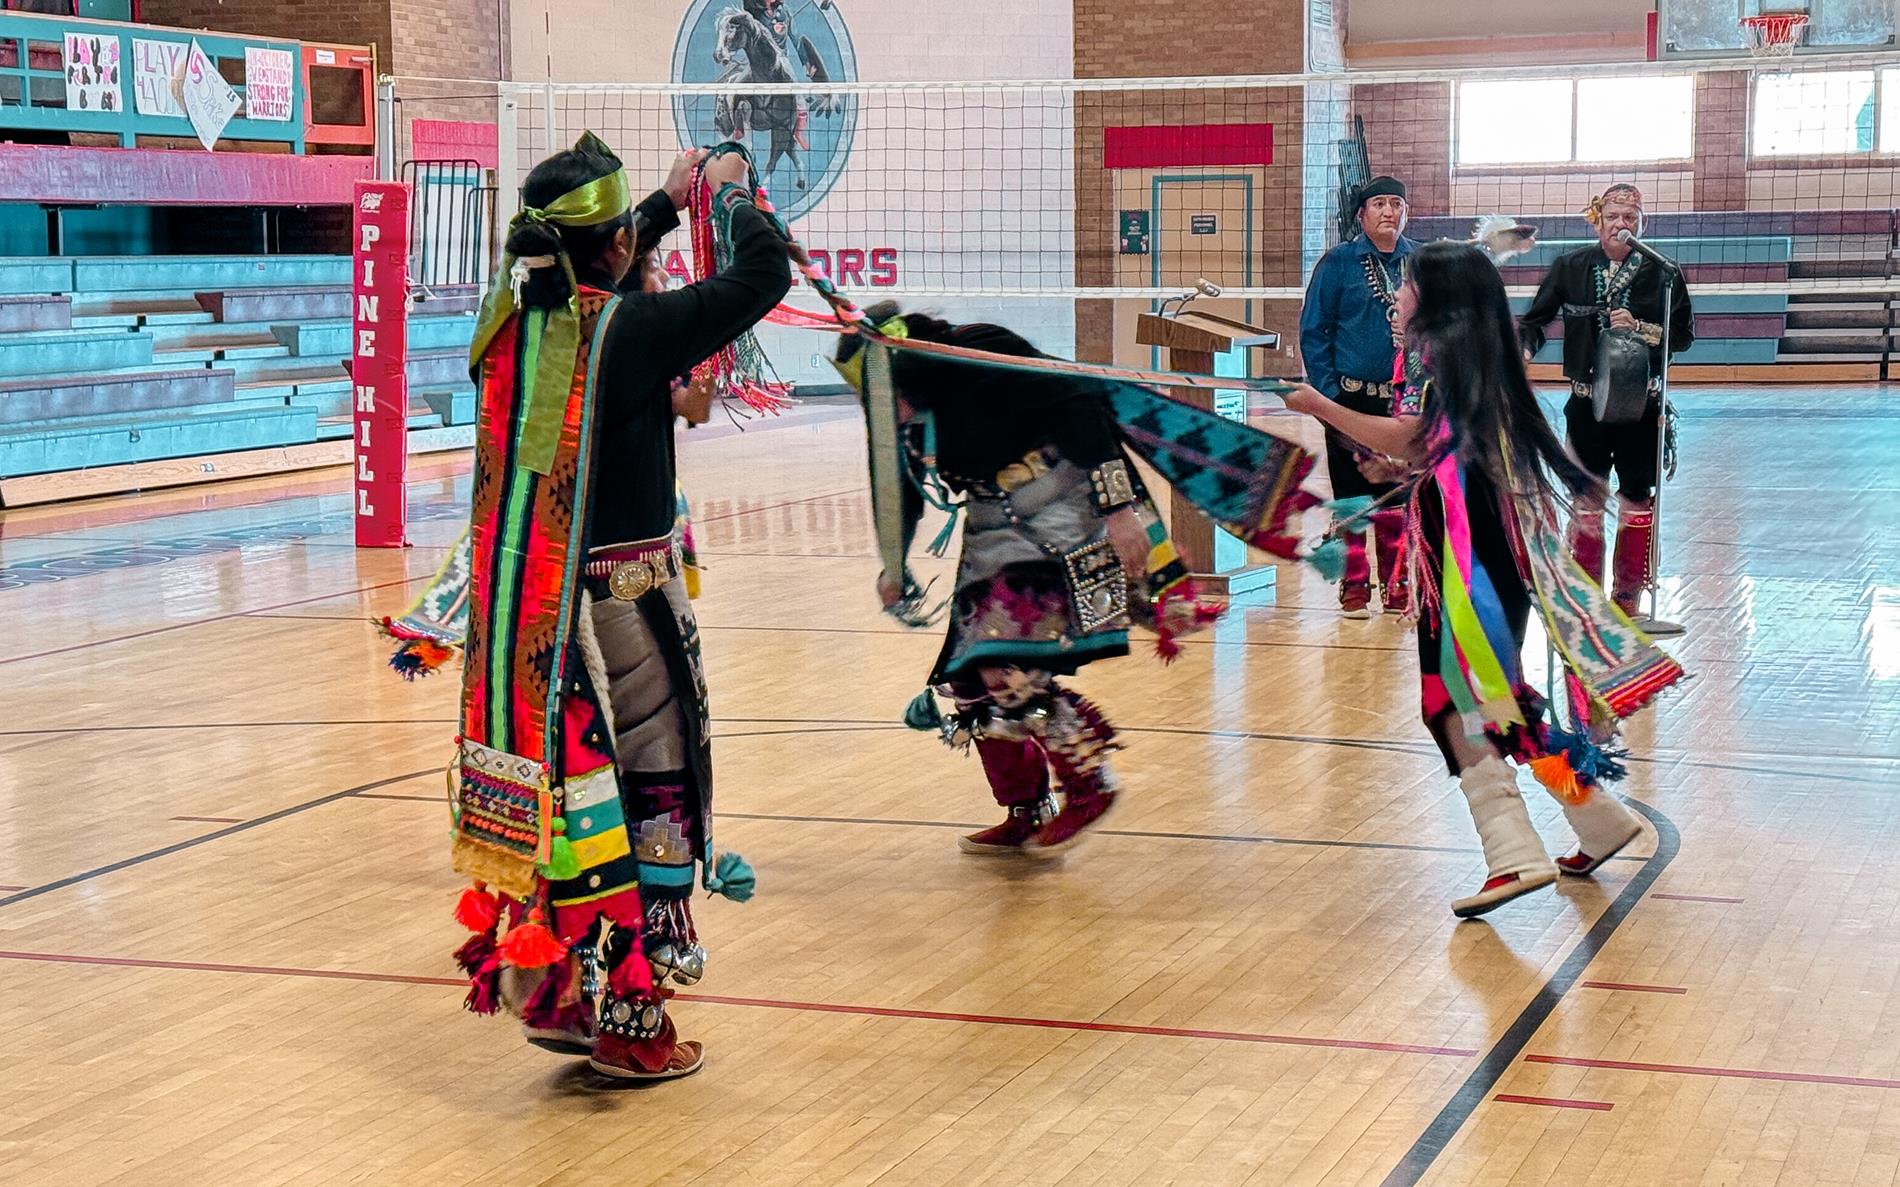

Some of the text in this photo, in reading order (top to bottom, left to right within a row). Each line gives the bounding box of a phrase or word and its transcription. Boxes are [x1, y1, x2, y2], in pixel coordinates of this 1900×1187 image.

[134, 41, 181, 77] PLAY
[247, 83, 275, 101] STRONG
[252, 100, 288, 118] WARRIORS
[358, 224, 381, 357] PINE
[356, 385, 376, 518] HILL
